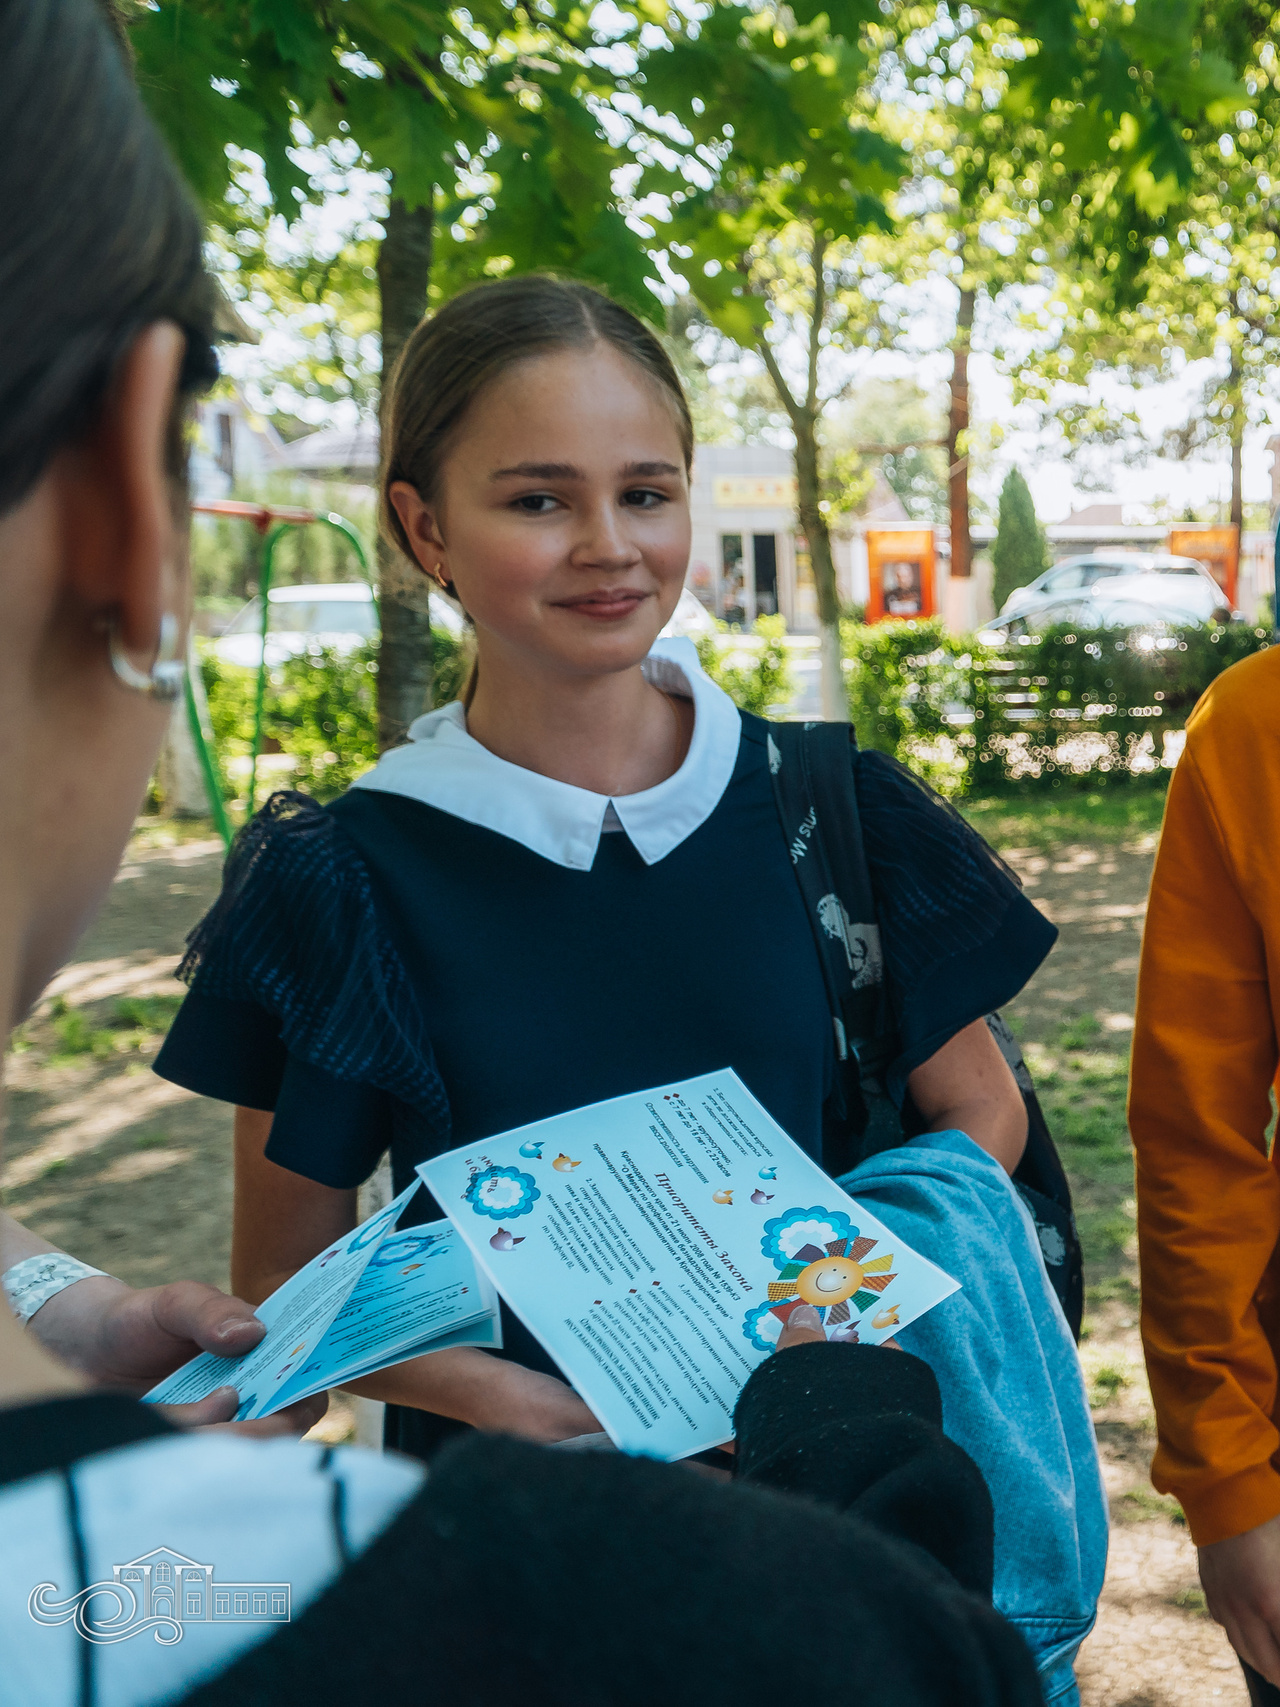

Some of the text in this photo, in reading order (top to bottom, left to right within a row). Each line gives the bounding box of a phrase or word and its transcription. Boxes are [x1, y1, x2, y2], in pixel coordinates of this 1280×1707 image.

[674, 1109, 685, 1119] лет
[681, 1119, 692, 1128] до
[695, 1136, 705, 1146] лет
[708, 1152, 719, 1161] 22
[714, 1161, 730, 1177] часов
[686, 1111, 697, 1121] лет
[564, 1184, 576, 1197] пива
[577, 1202, 593, 1221] табака
[578, 1187, 621, 1239] спиртосодержащей
[588, 1182, 613, 1213] Запрещена
[610, 1212, 630, 1237] продажа
[592, 1143, 633, 1192] правонарушений
[628, 1192, 677, 1255] несовершеннолетних
[678, 1260, 717, 1304] Краснодарском
[619, 1149, 657, 1197] Краснодарского
[654, 1197, 668, 1212] края
[664, 1211, 673, 1219] от
[670, 1219, 680, 1227] 21
[676, 1227, 692, 1244] июля
[689, 1243, 704, 1258] 2008
[699, 1258, 714, 1271] года
[718, 1279, 741, 1301] 1539-КЗ
[624, 1172, 642, 1192] Мерах
[639, 1192, 648, 1201] по
[645, 1201, 680, 1244] профилактике
[676, 1243, 716, 1289] безнадзорности
[653, 1171, 752, 1292] Приоритеты Закона
